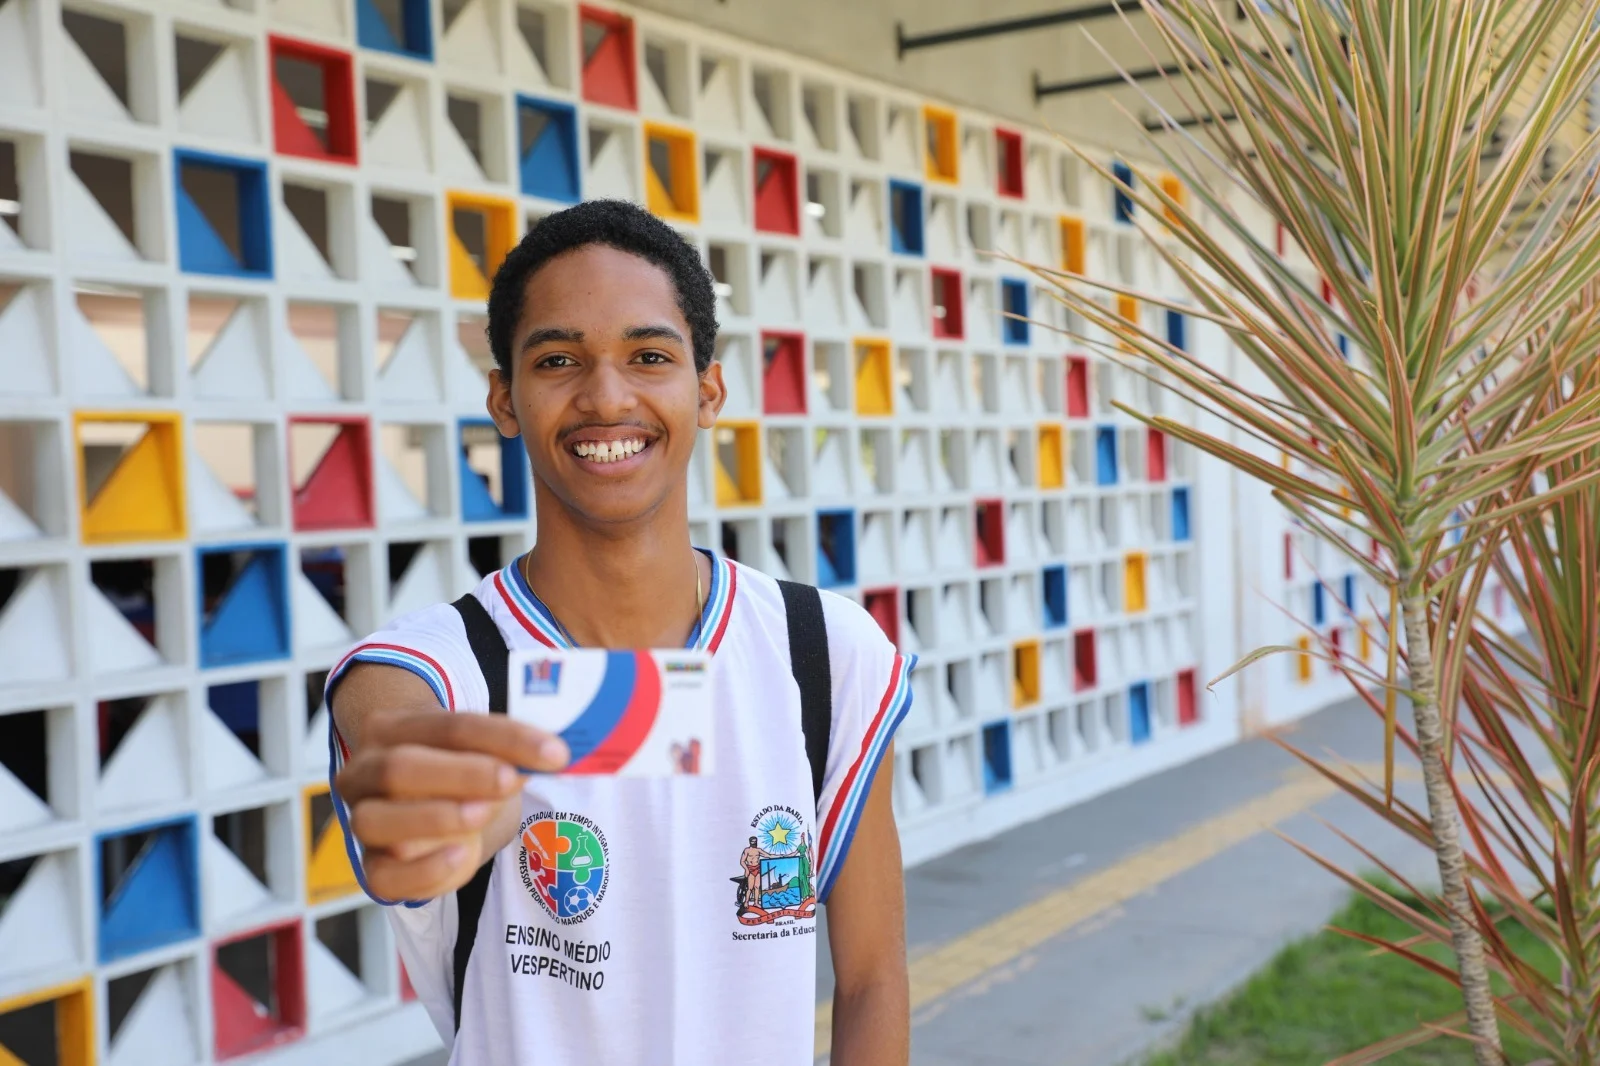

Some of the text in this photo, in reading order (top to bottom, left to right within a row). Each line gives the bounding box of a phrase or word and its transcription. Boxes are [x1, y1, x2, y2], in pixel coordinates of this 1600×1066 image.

[526, 810, 554, 825] ESTADUAL
[555, 811, 567, 820] EM
[569, 812, 593, 828] TEMPO
[591, 824, 610, 858] INTEGRAL
[750, 805, 773, 828] ESTADO
[785, 806, 804, 826] BAHIA
[518, 845, 533, 889] PROFESSOR
[531, 887, 546, 910] PEDRO
[560, 907, 595, 926] MARQUES
[596, 863, 610, 905] MARQUES
[505, 924, 611, 964] ENSINO MÉDIO
[732, 930, 778, 941] Secretaria
[780, 928, 790, 938] da
[511, 953, 604, 991] VESPERTINO
